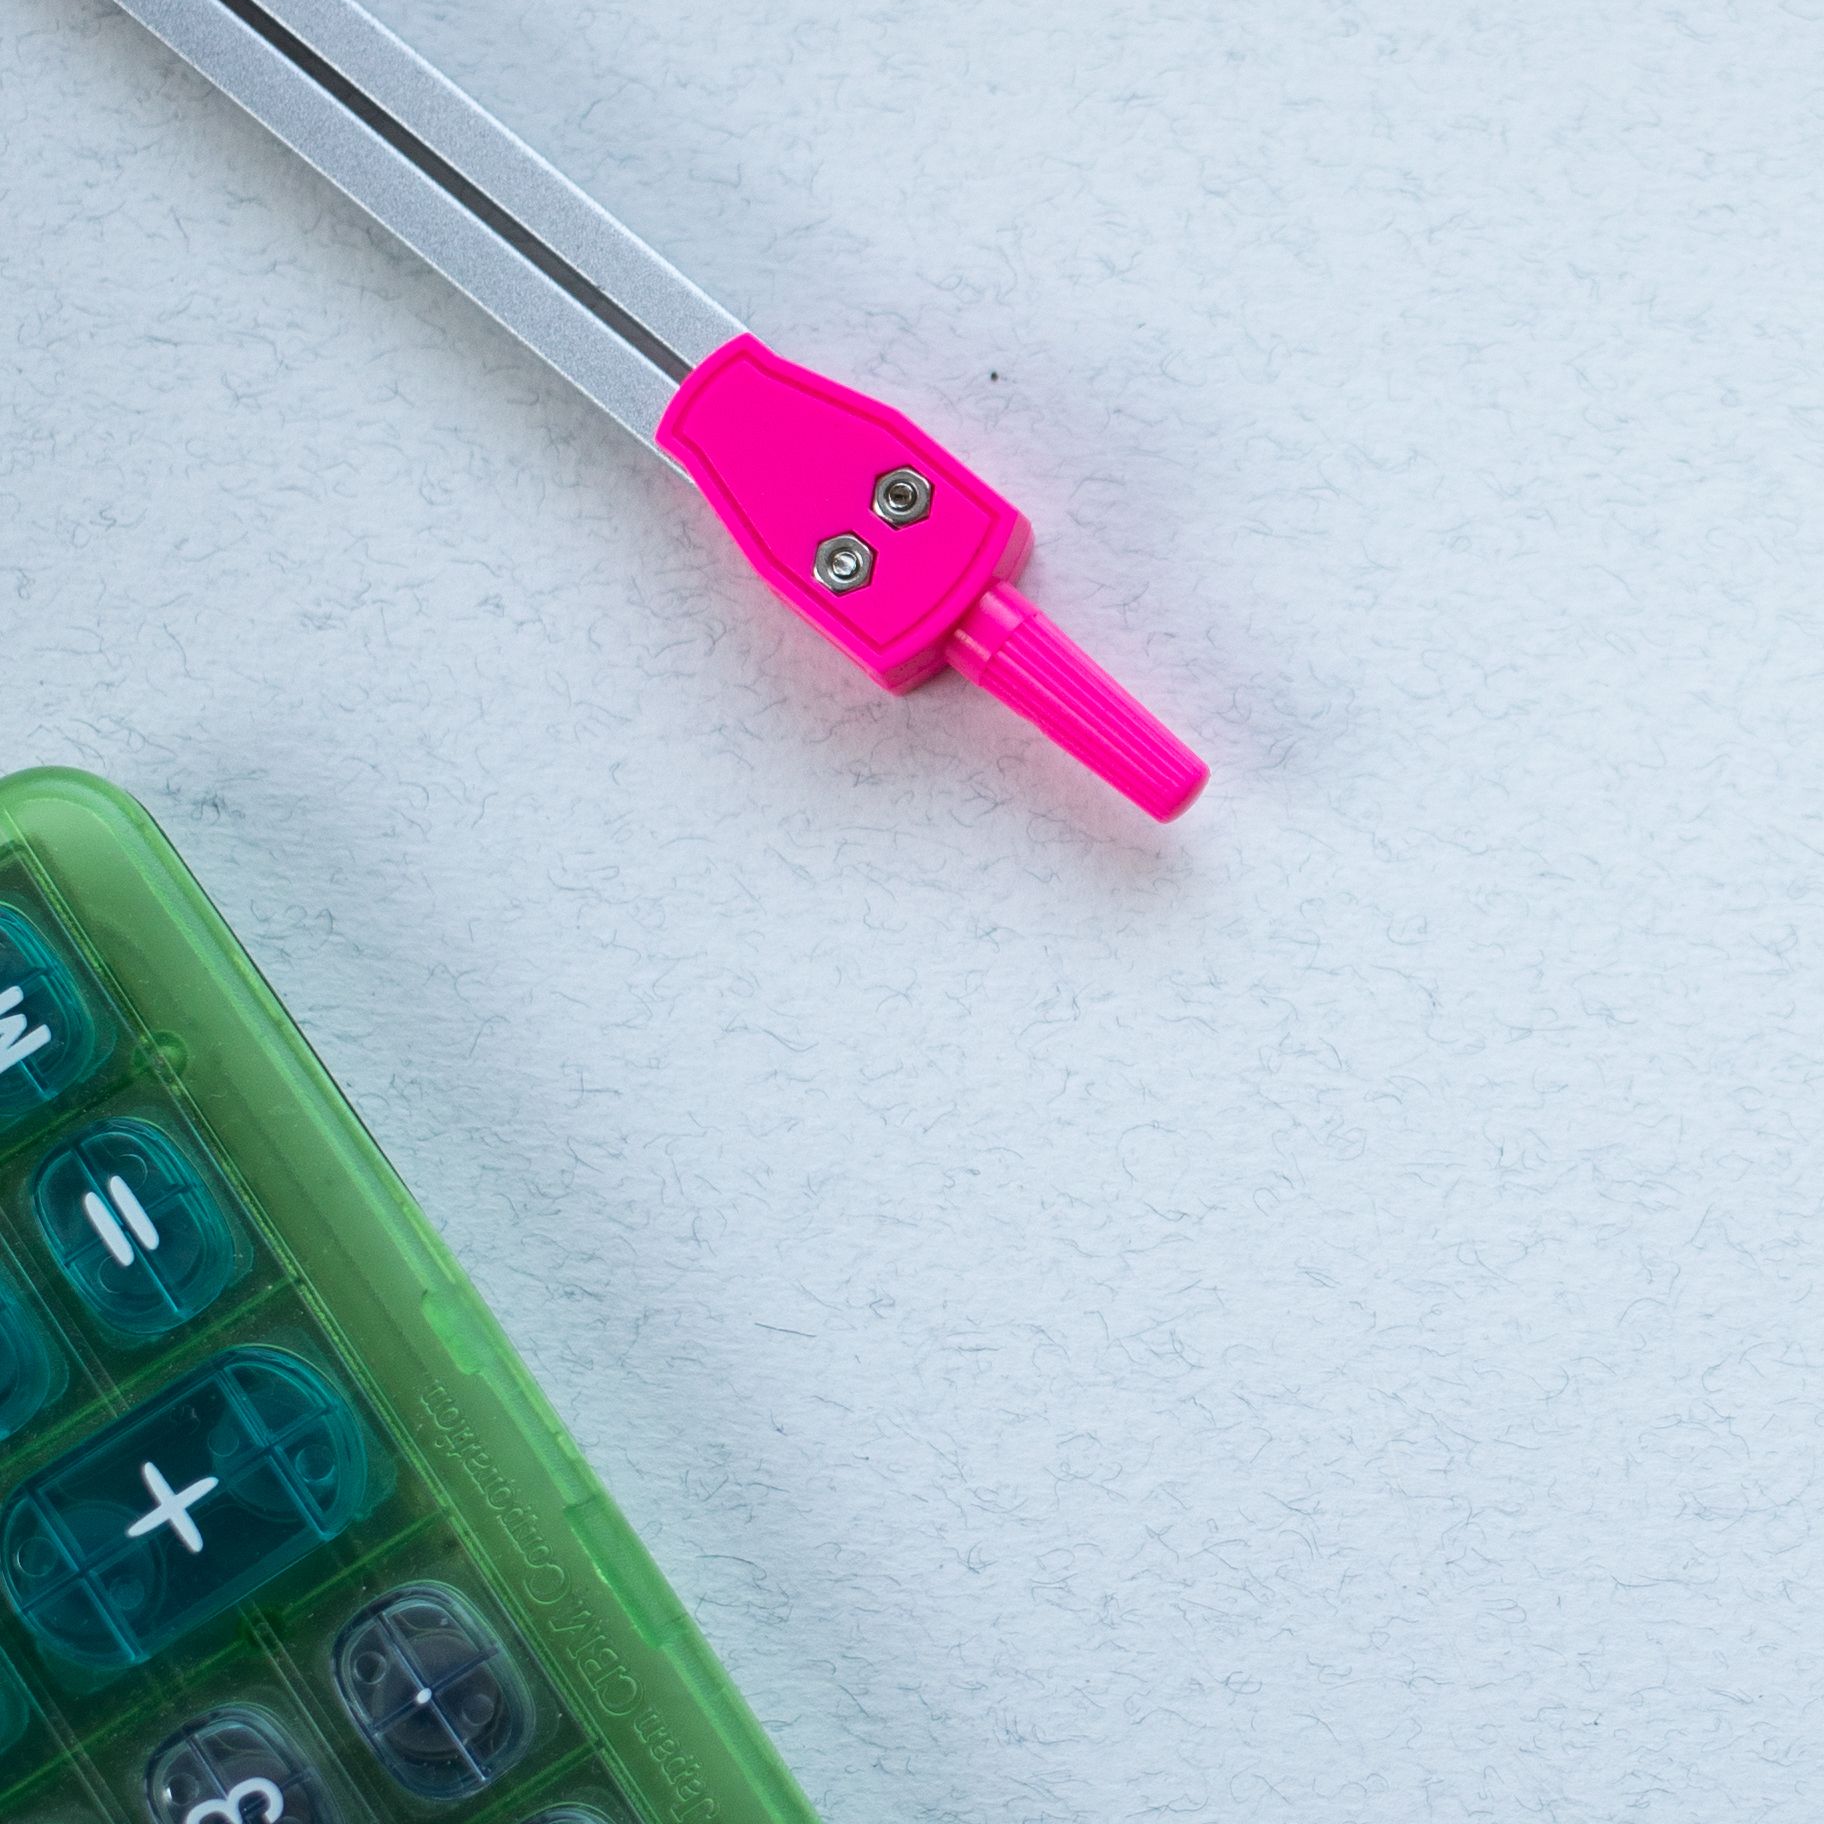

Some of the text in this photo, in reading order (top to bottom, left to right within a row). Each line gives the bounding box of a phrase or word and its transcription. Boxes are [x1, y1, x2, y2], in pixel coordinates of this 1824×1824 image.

[128, 1462, 217, 1552] +
[420, 1379, 719, 1824] Japan CBM Corporation
